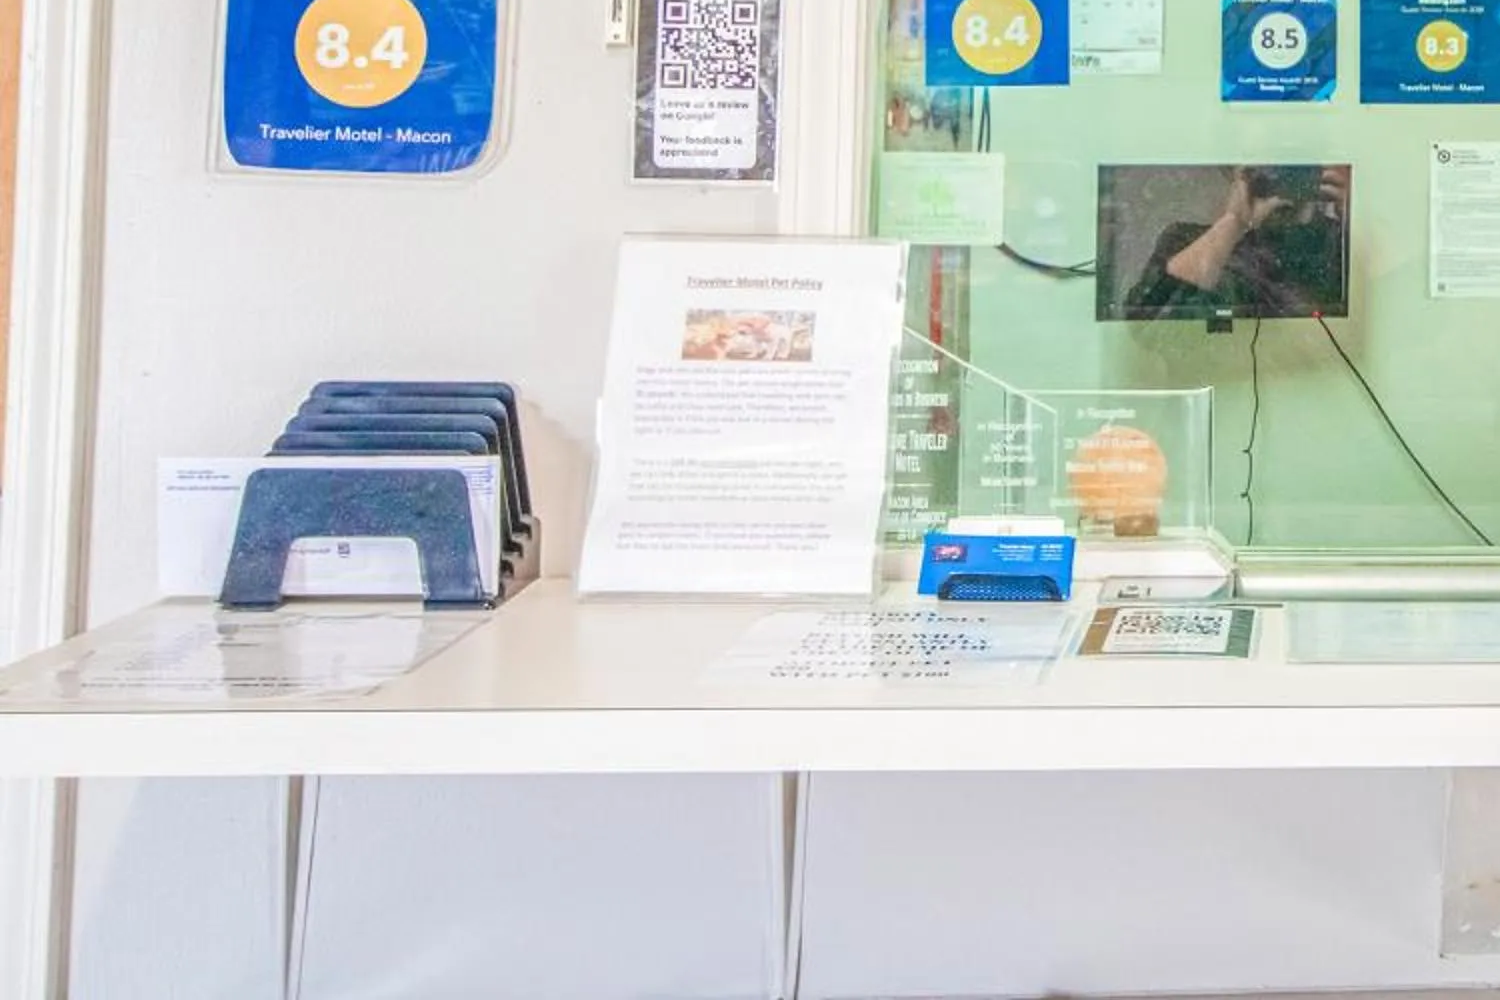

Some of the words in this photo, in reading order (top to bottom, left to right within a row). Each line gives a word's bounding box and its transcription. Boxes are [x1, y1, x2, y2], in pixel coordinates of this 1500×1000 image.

[965, 14, 1031, 48] 8.4
[1260, 28, 1299, 49] 8.5
[315, 23, 409, 69] 8.4
[1425, 36, 1459, 57] 8.3
[335, 126, 382, 143] Motel
[396, 128, 452, 144] Macon
[771, 277, 789, 290] Pet
[791, 278, 823, 292] Policy
